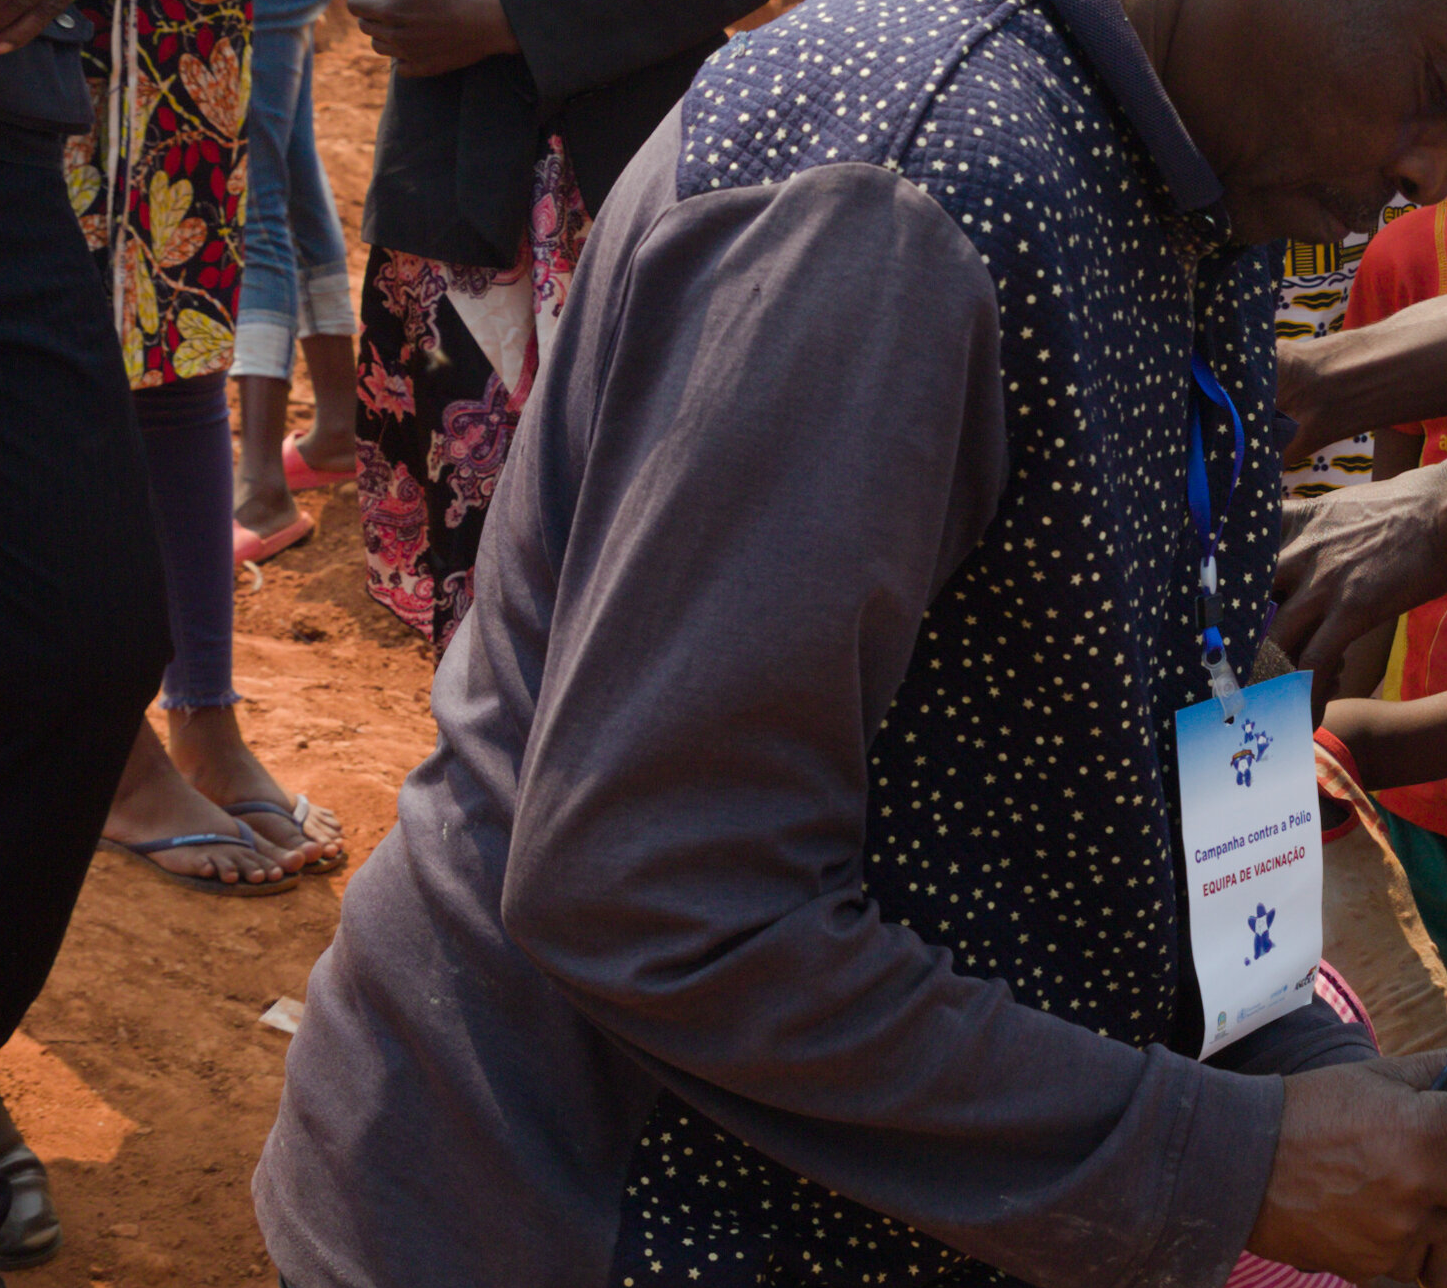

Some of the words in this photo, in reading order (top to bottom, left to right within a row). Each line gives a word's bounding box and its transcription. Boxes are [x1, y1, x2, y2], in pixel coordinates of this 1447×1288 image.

[1194, 836, 1245, 864] Campanha
[1248, 825, 1279, 844] contra
[1281, 821, 1287, 832] a
[1289, 810, 1312, 829] Pólio
[1202, 873, 1237, 897] EQUIPA
[1239, 867, 1252, 883] DE
[1254, 845, 1305, 877] VACINAÇÃO
